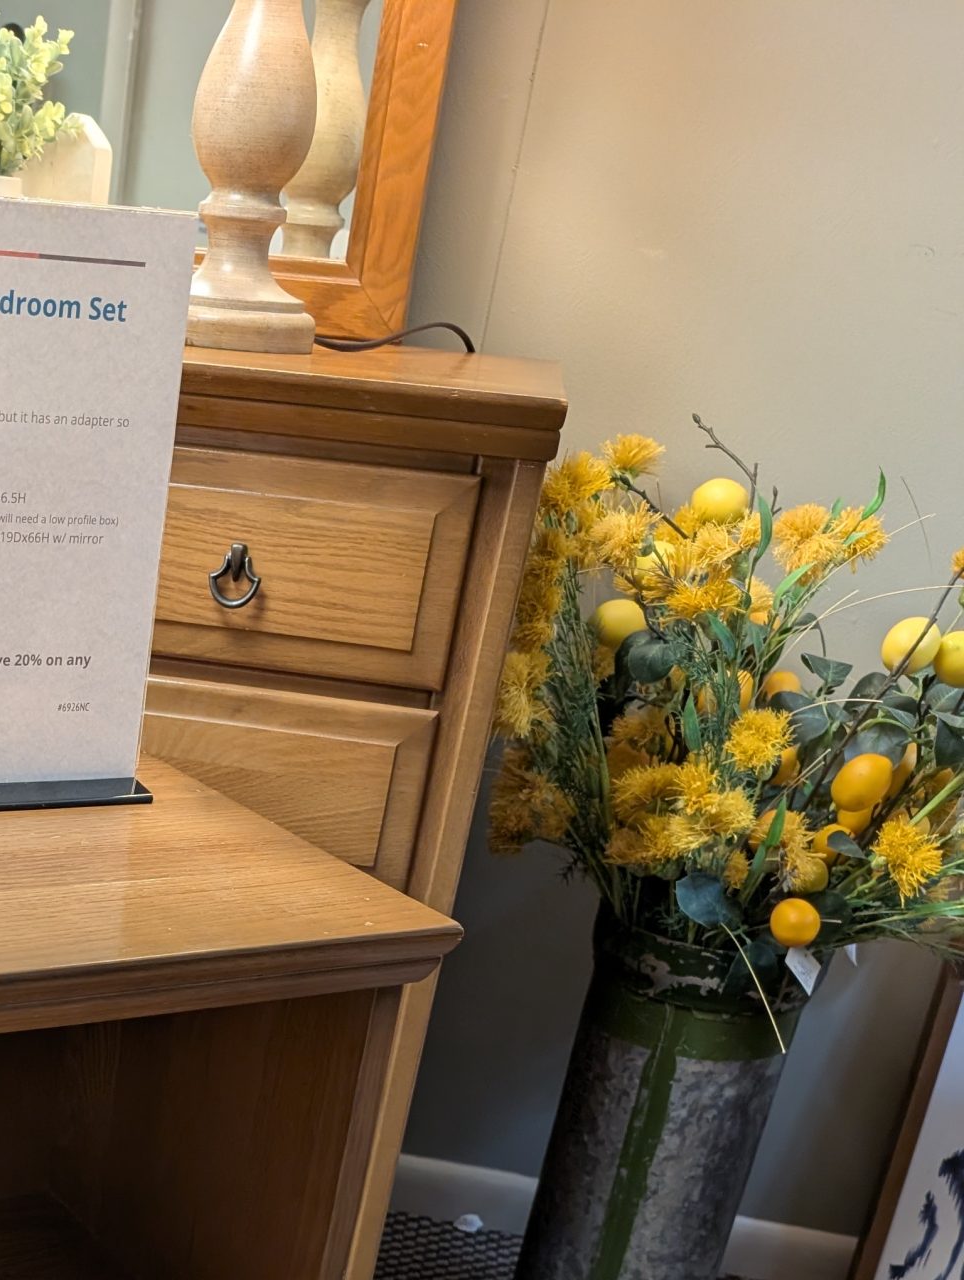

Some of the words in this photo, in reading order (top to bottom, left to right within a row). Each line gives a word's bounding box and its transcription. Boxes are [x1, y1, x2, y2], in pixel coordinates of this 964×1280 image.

[88, 296, 128, 323] Set
[20, 411, 28, 424] it
[31, 411, 51, 425] has
[53, 415, 68, 425] an
[70, 413, 115, 429] adapter
[116, 418, 130, 428] so
[15, 513, 39, 524] need
[40, 516, 47, 524] a
[49, 514, 66, 525] low
[67, 514, 97, 527] profile
[99, 515, 119, 527] box)
[52, 532, 67, 544] w/
[68, 532, 104, 545] mirror
[13, 653, 43, 667] 20%
[45, 656, 63, 667] on
[66, 655, 92, 670] any
[57, 702, 91, 712] #6926NC
